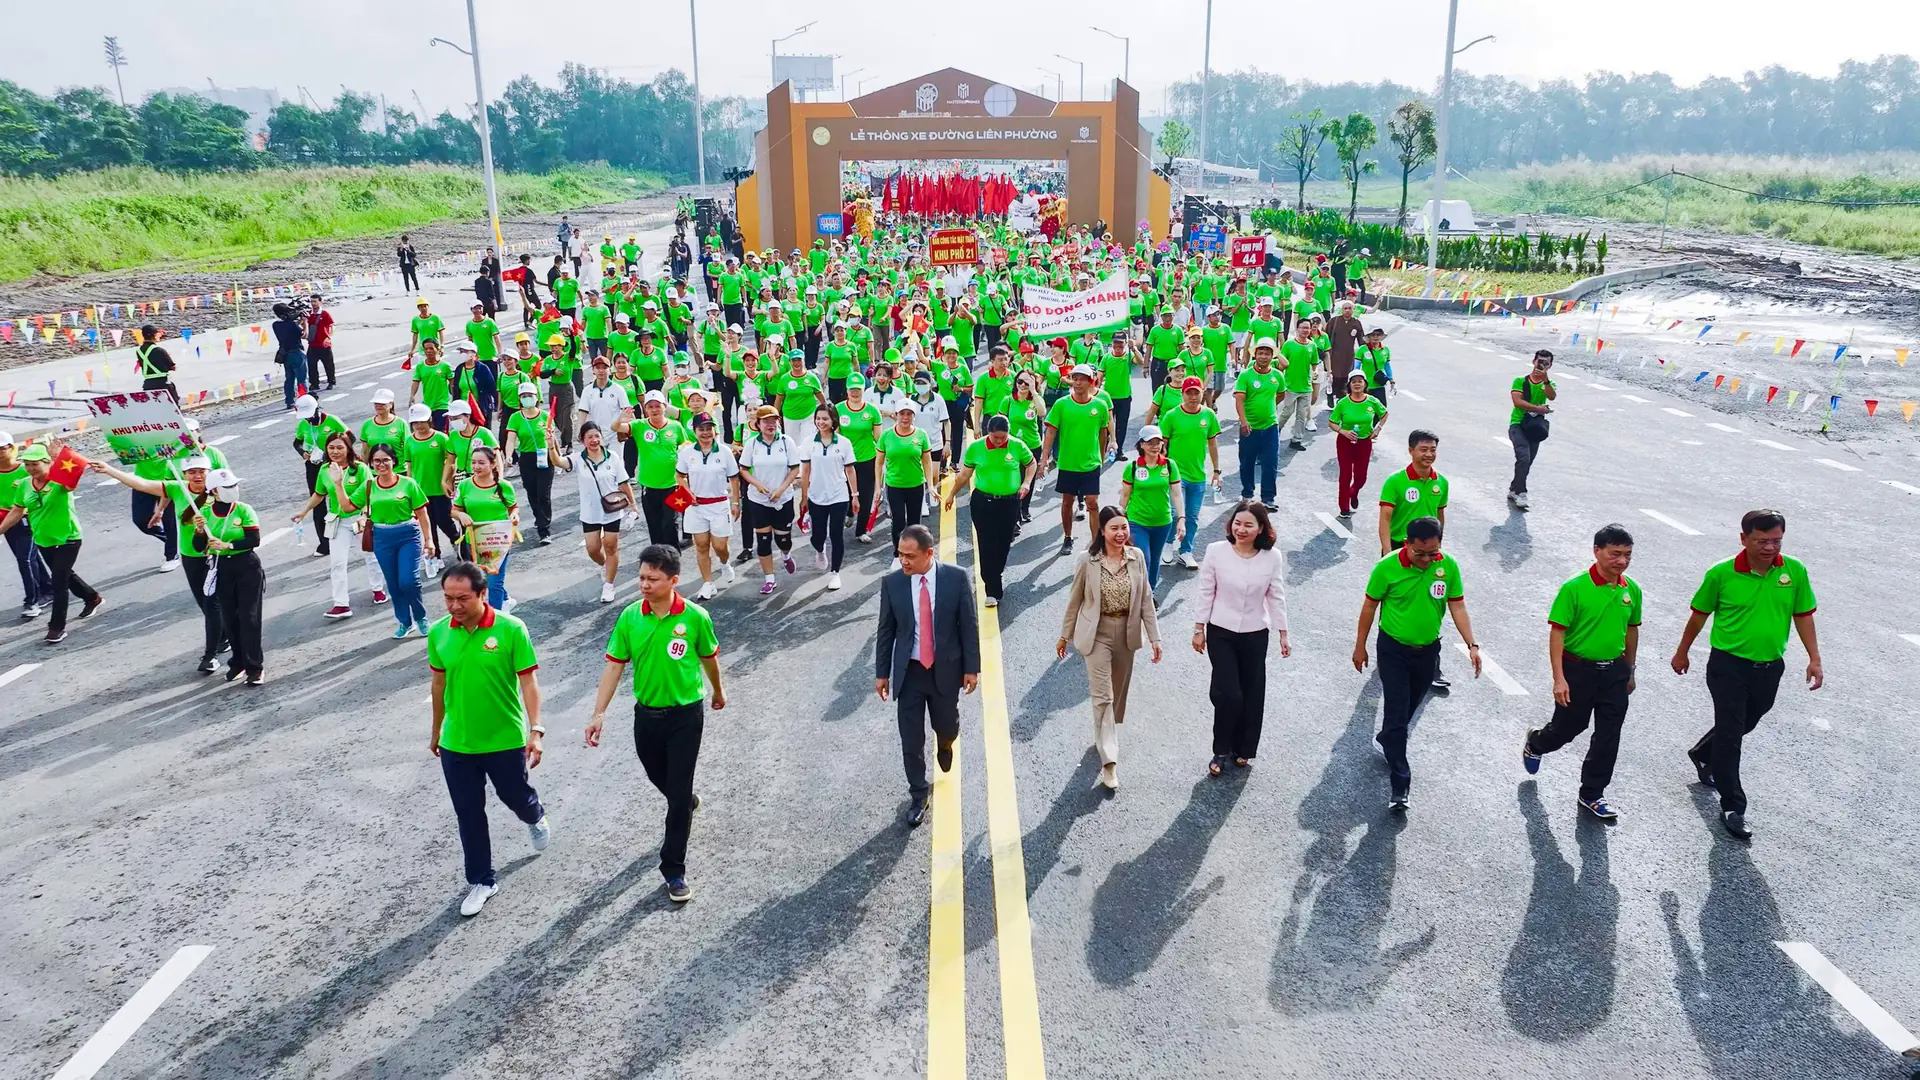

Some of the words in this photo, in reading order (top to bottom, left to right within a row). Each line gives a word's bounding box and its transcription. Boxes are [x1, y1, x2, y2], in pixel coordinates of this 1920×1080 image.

[850, 128, 866, 140] LỄ
[866, 129, 909, 140] THÔNG
[910, 132, 927, 140] XE
[928, 128, 974, 140] ĐƯỜNG
[976, 128, 1002, 140] LIÊN
[1004, 128, 1058, 140] PHƯỜNG
[934, 249, 948, 260] KHU
[950, 245, 964, 260] PHỐ
[966, 248, 974, 259] 21
[1242, 254, 1256, 265] 44
[1064, 315, 1075, 324] 42
[1084, 312, 1096, 321] 50
[1106, 310, 1115, 318] 51
[111, 427, 132, 436] KHU
[132, 420, 151, 433] PHỐ
[1137, 471, 1147, 479] 199
[1407, 491, 1418, 500] 121
[671, 642, 685, 656] 99
